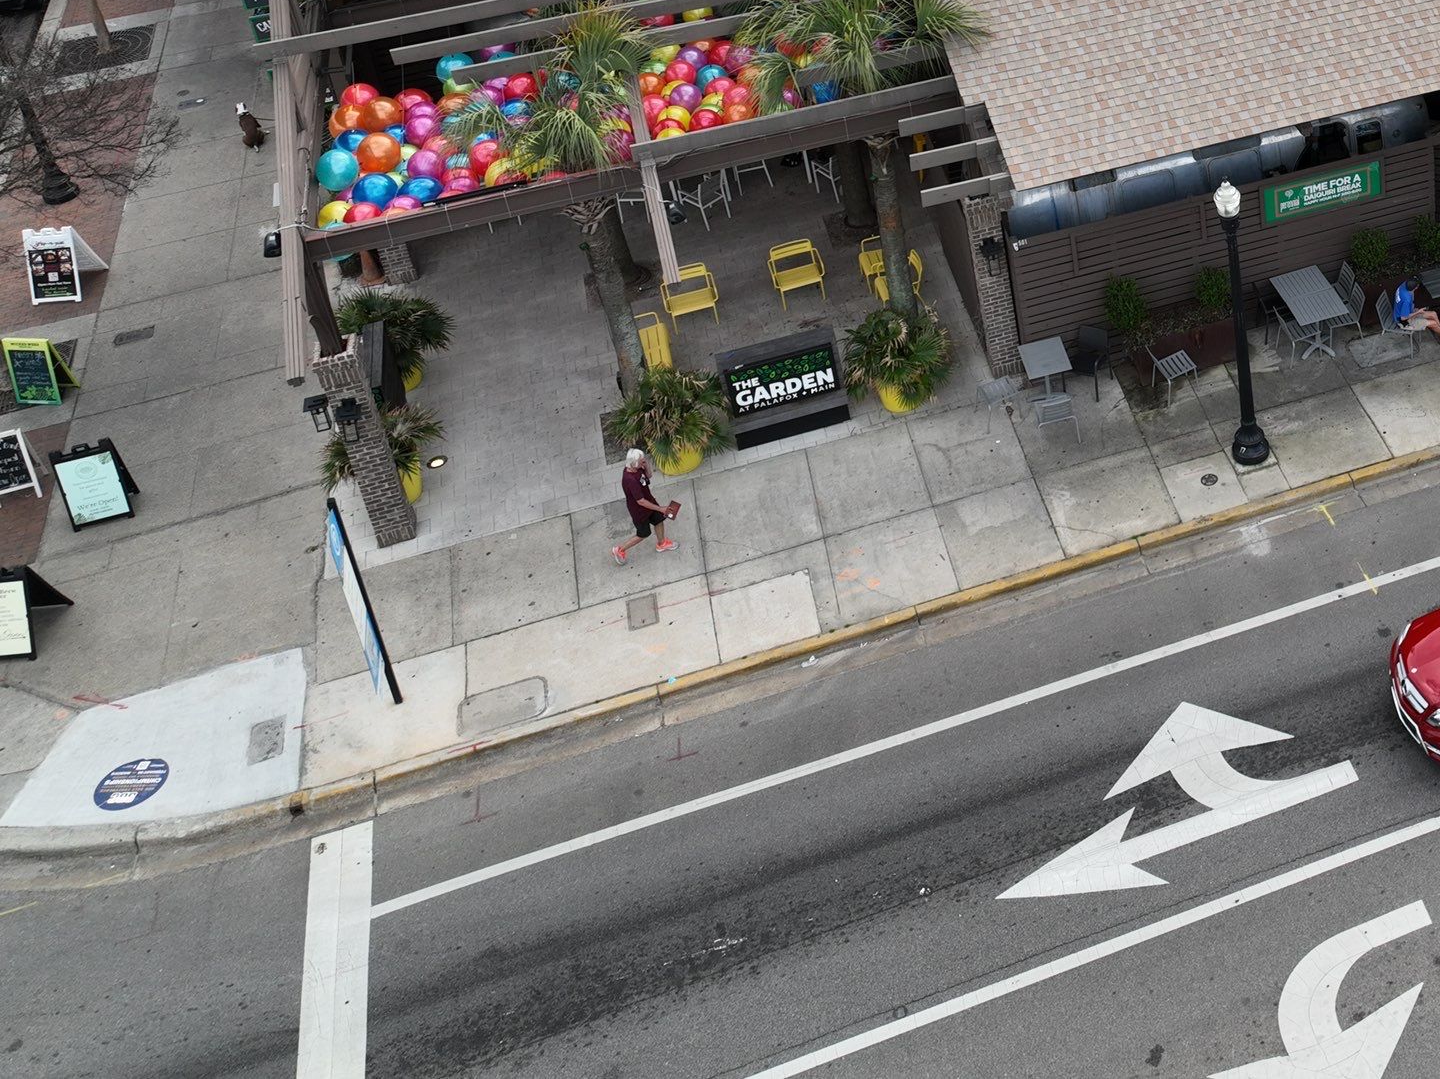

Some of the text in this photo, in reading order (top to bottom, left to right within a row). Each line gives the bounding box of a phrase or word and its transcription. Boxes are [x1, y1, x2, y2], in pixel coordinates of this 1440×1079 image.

[1303, 173, 1362, 195] TIME FOR A
[1303, 182, 1362, 202] DAIQUIRI BREAK
[732, 377, 760, 391] THE
[735, 367, 835, 407] GARDEN
[739, 405, 750, 413] AT
[754, 393, 798, 409] PALAFOX
[810, 383, 835, 395] MAIN
